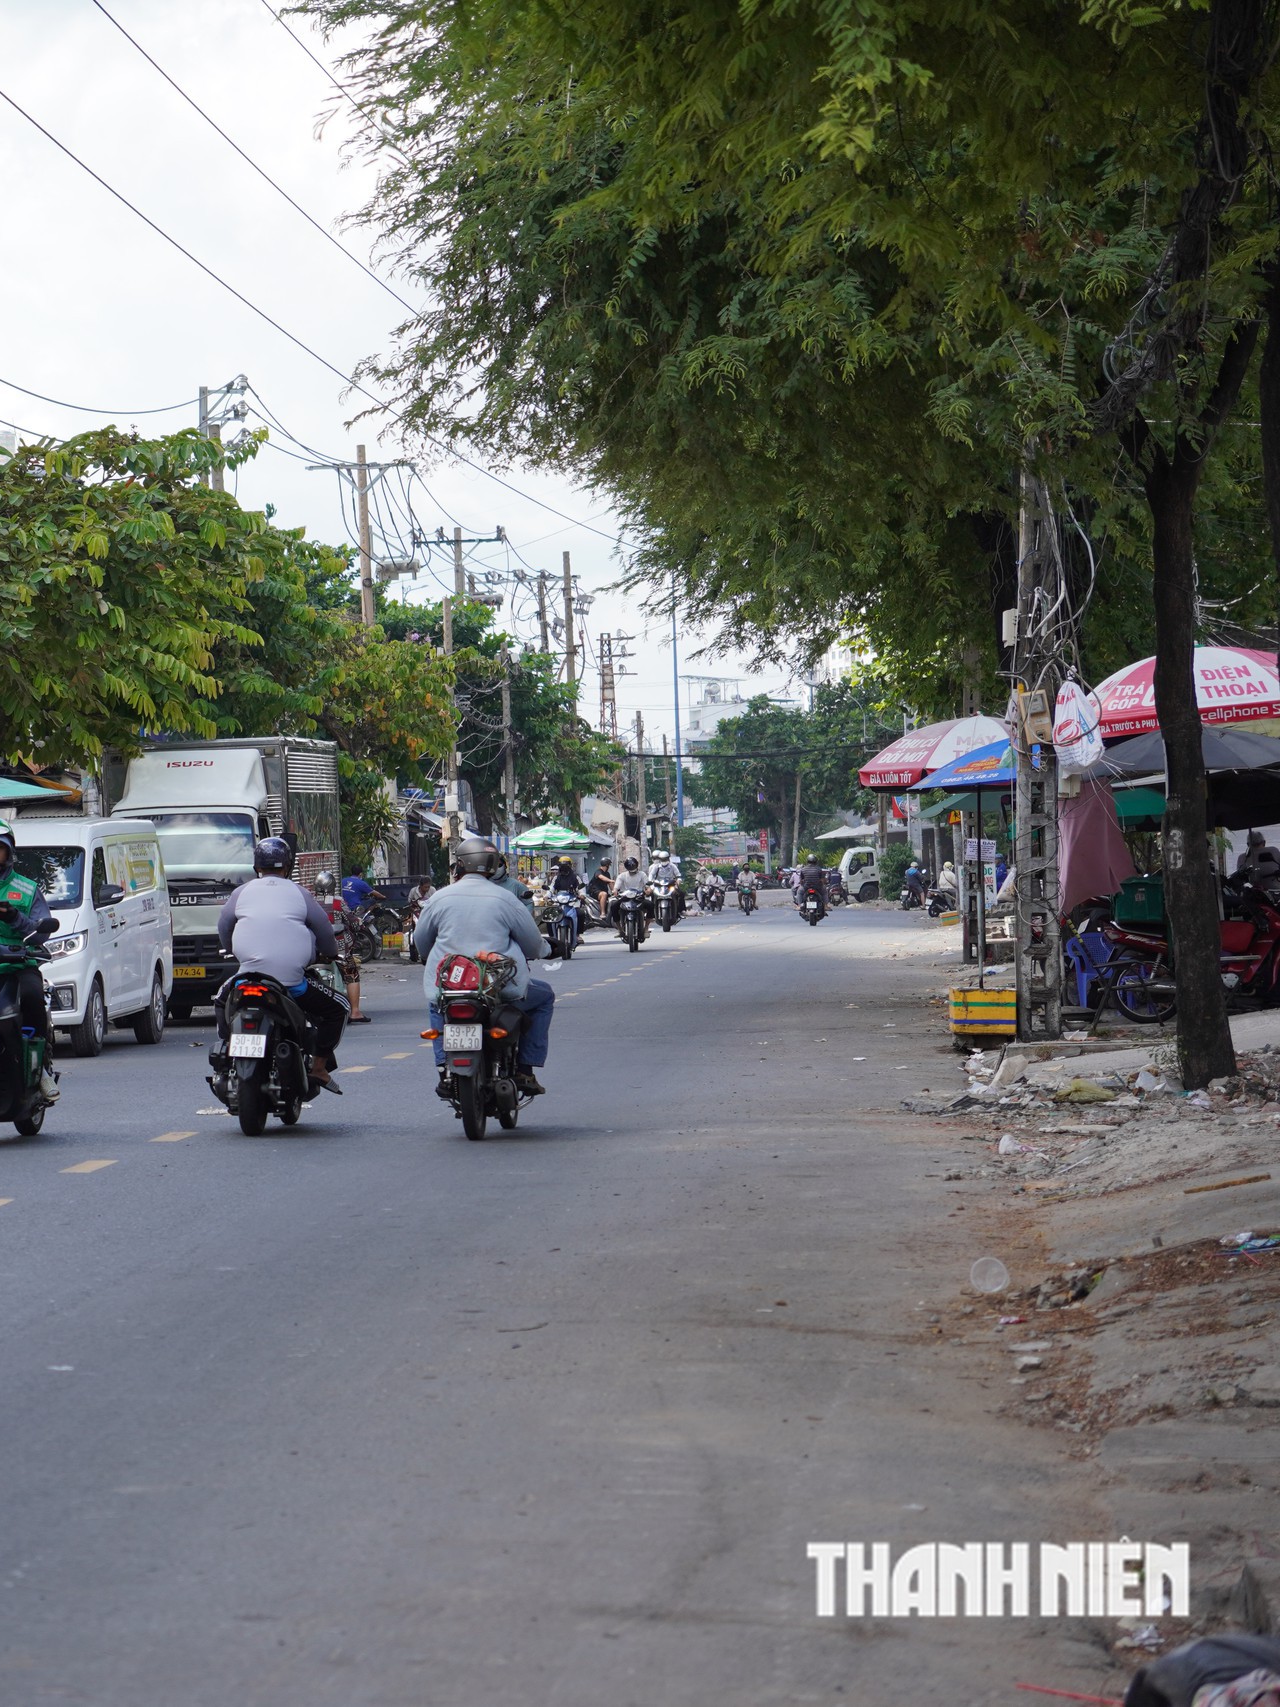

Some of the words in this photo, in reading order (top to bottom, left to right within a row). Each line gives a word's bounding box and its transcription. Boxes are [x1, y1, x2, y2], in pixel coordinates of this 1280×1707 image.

[1200, 665, 1252, 682] ĐIỆN
[1116, 681, 1145, 696] TRẢ
[1200, 681, 1268, 699] THOẠI
[1108, 697, 1140, 711] GÓP
[869, 772, 882, 784] GIÁ
[882, 771, 898, 784] LUÔN
[900, 770, 912, 784] TỐT
[171, 896, 197, 905] UZU
[307, 977, 333, 997] adidas
